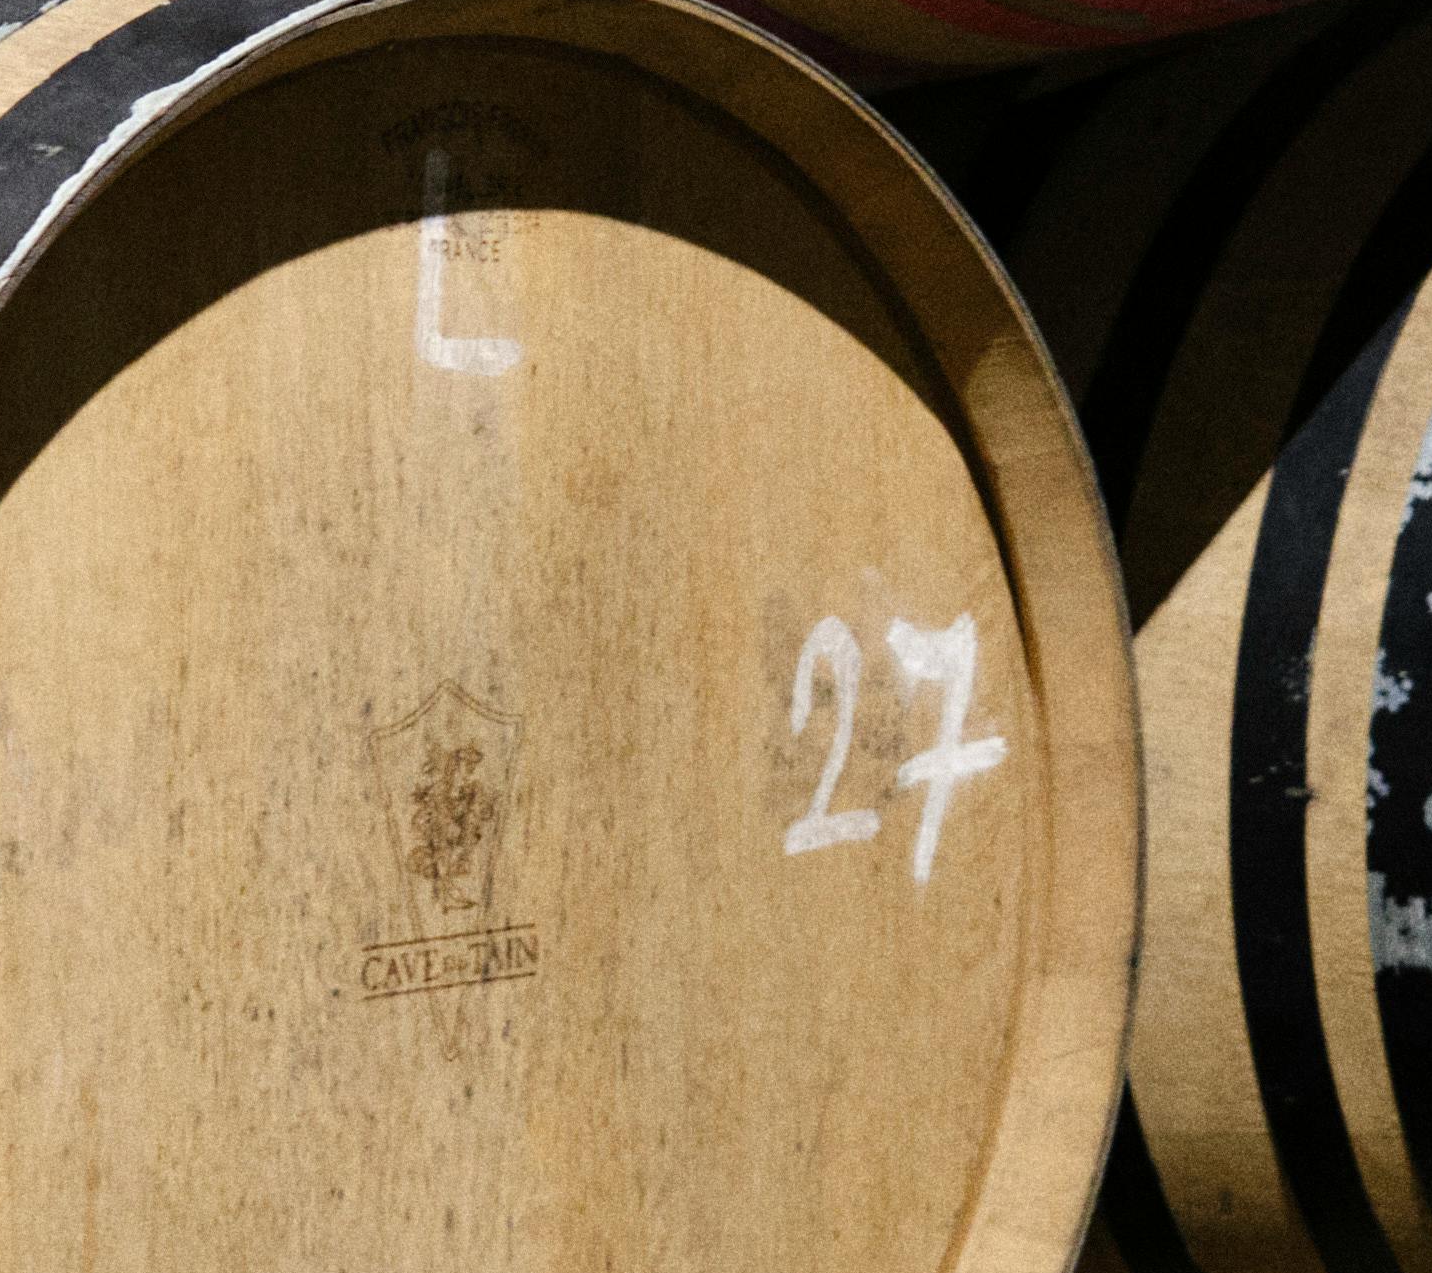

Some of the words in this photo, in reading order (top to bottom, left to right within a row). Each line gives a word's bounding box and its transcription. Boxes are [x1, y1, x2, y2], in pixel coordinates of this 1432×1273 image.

[415, 149, 524, 377] L
[782, 612, 1010, 885] 27
[361, 949, 438, 991] CAVE
[469, 936, 538, 976] TAIN
